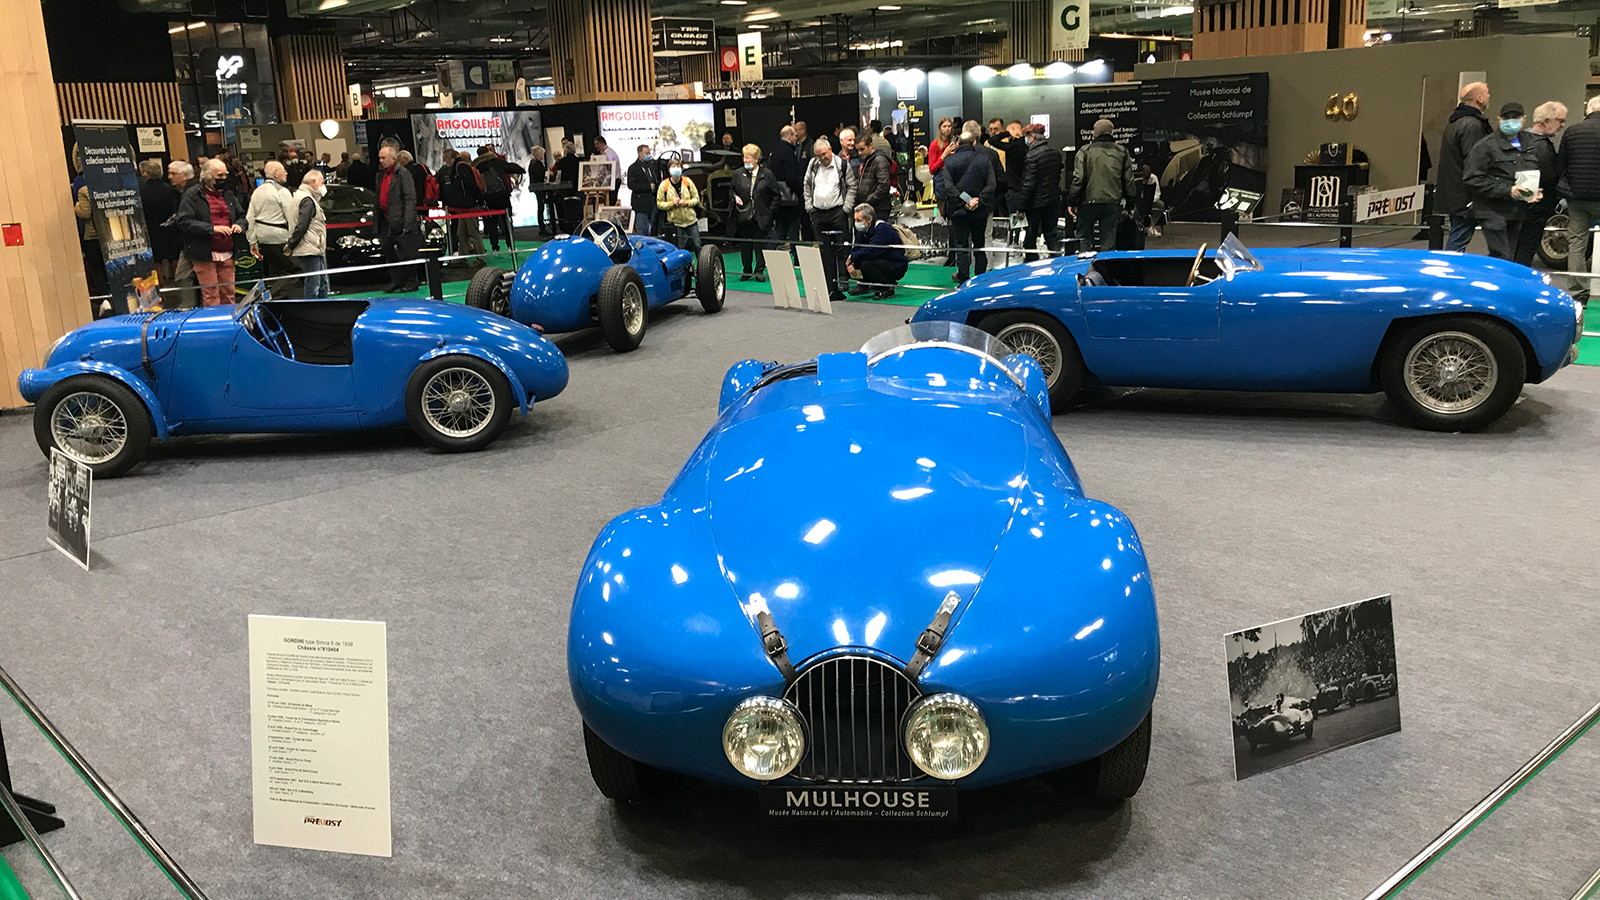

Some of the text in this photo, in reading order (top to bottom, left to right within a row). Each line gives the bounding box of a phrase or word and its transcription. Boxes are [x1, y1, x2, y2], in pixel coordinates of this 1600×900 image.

[1060, 4, 1080, 31] G
[744, 45, 756, 66] E
[1189, 86, 1252, 97] Musée National de
[352, 92, 359, 106] B
[1113, 100, 1123, 108] plus
[1187, 109, 1254, 120] Collection Schlumpf
[438, 128, 501, 139] CIRCUIT DES
[456, 137, 502, 147] REMPARTS
[786, 791, 930, 808] MULHOUSE
[830, 809, 873, 817] l'Automobile
[916, 810, 949, 818] Schlumpf
